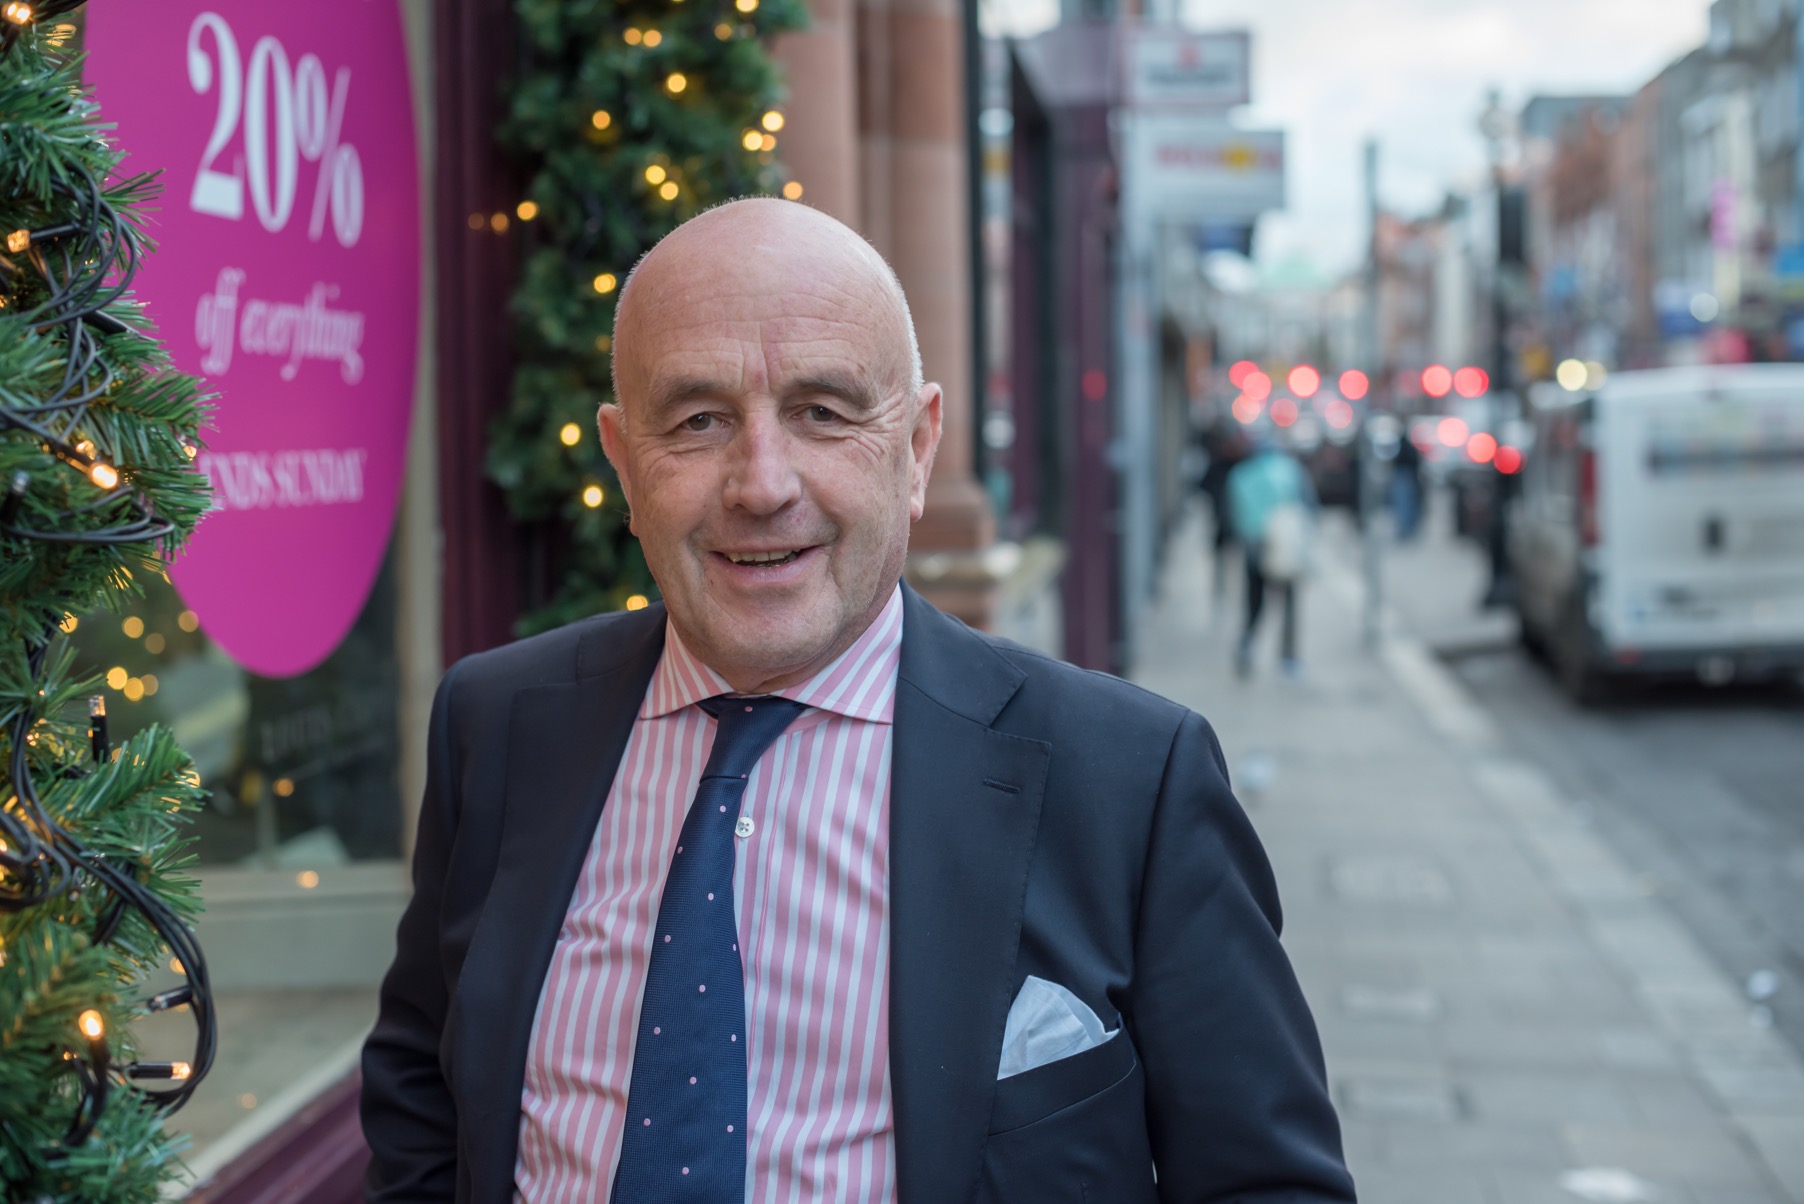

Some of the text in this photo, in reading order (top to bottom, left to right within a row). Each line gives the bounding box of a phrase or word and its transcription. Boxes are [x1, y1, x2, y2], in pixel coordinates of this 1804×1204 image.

[187, 11, 364, 248] 20%
[195, 266, 365, 385] off everything
